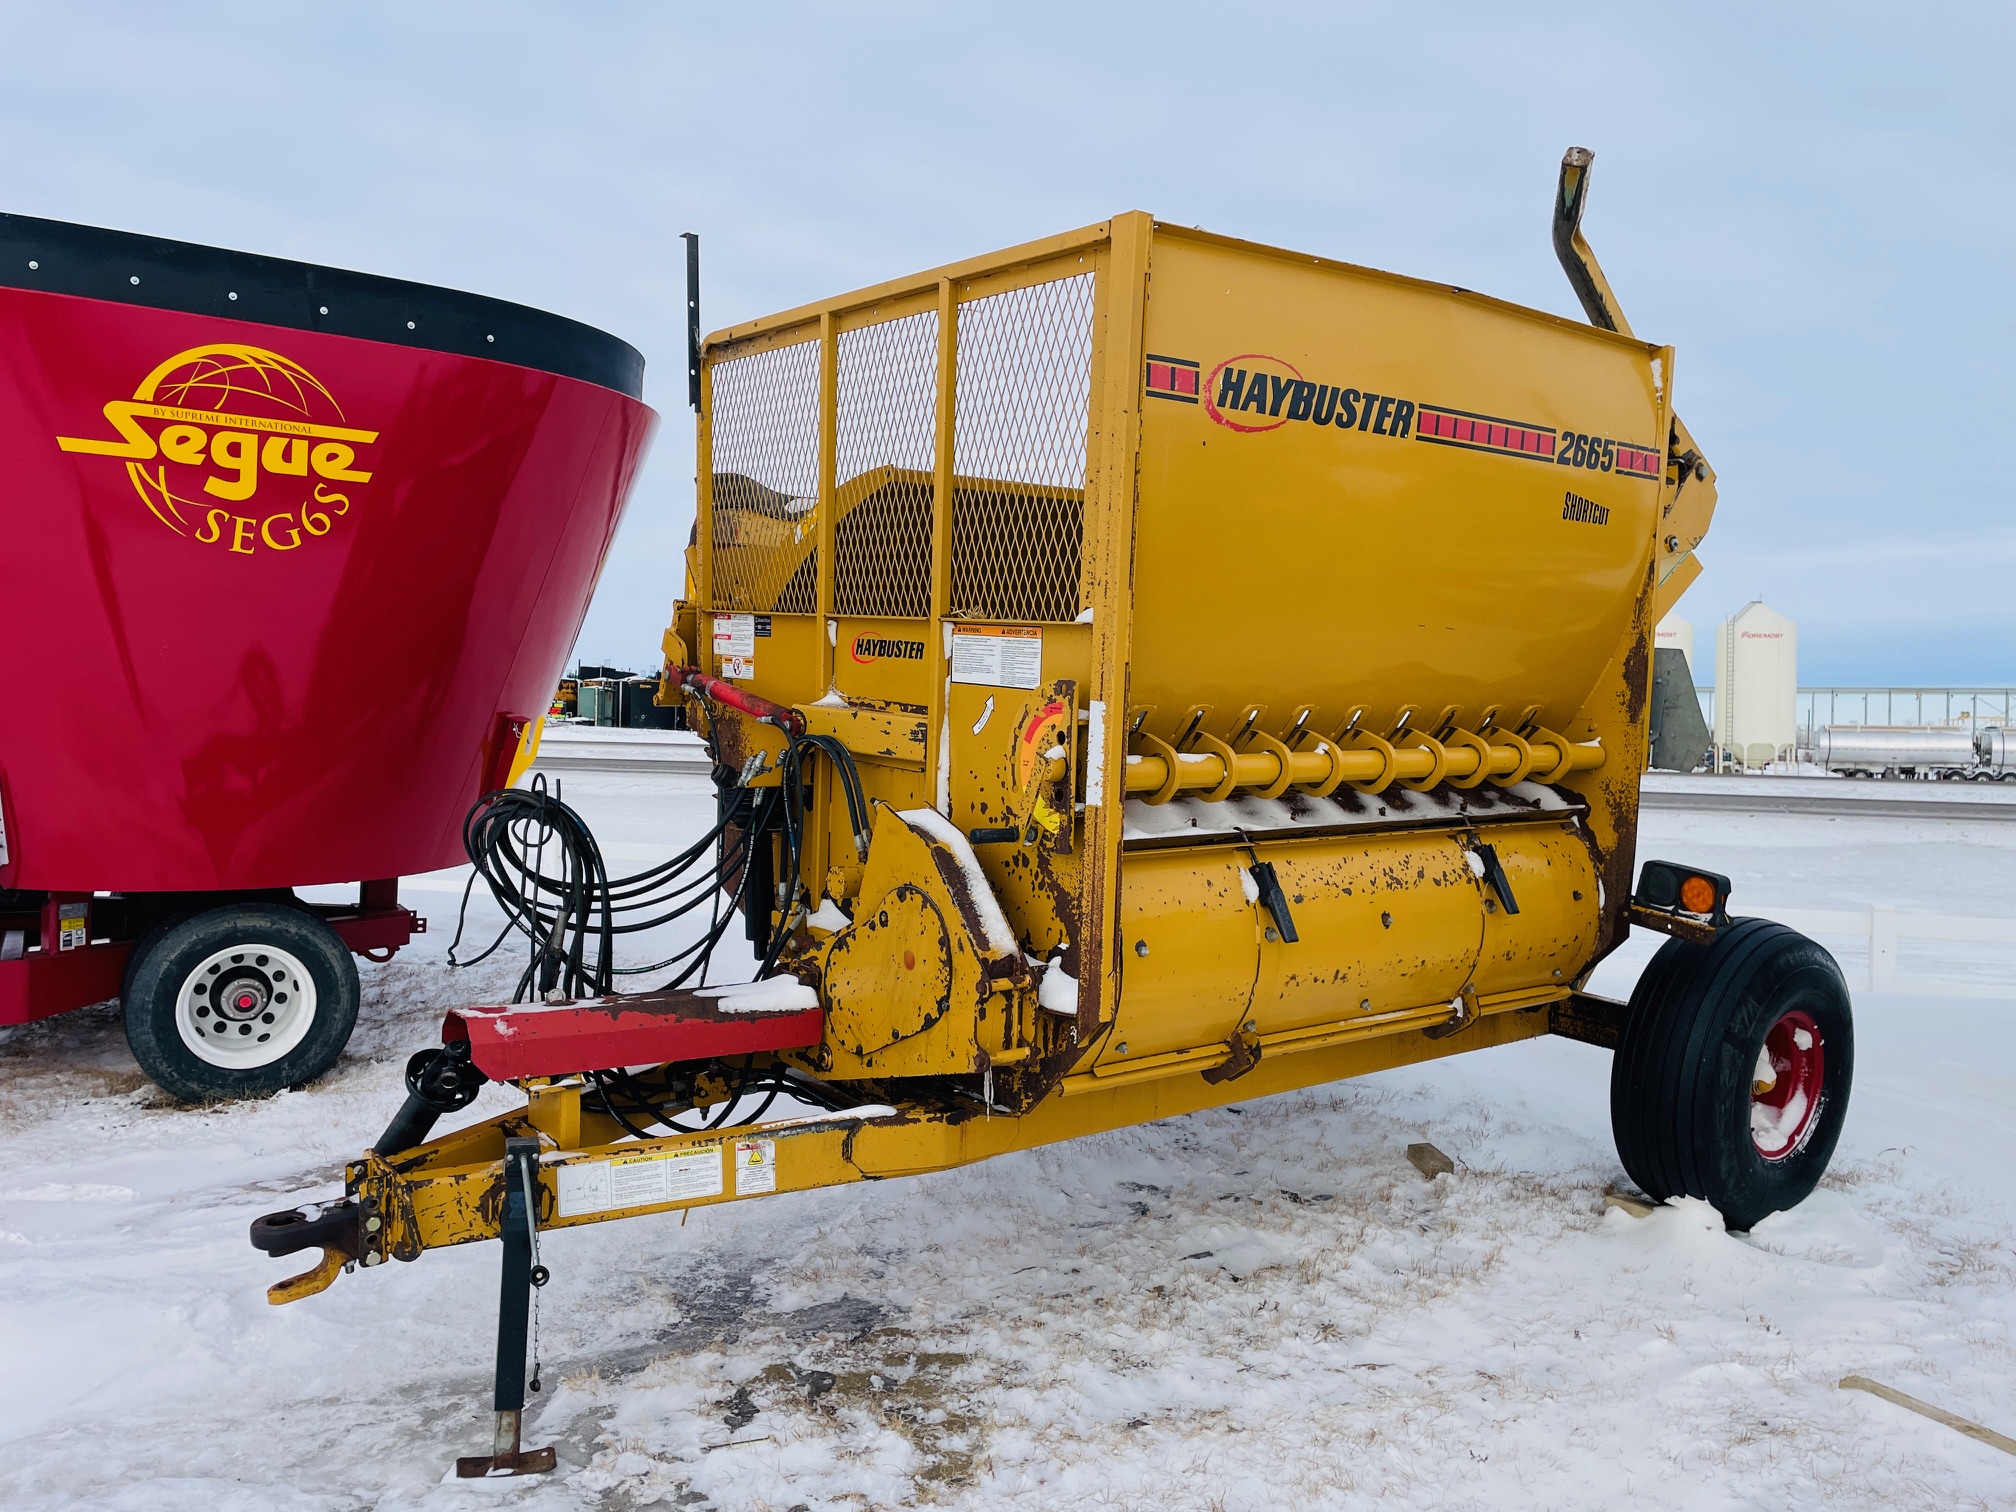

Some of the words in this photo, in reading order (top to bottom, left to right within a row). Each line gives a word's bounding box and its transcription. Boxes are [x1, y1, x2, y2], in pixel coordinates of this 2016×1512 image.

[153, 407, 167, 417] BY
[170, 409, 221, 423] SUPREME
[224, 416, 314, 435] INTERNATIONAL
[1216, 366, 1415, 438] HAYBUSTER
[1556, 431, 1616, 472] 2665
[56, 400, 380, 501] Segue
[195, 482, 350, 555] SEG6S
[1562, 491, 1610, 526] SHORTCUT
[855, 638, 925, 660] HAYBUSTER
[1656, 631, 1677, 639] MOST
[1740, 631, 1784, 639] FOREMOST
[629, 1156, 653, 1164] CAUTION
